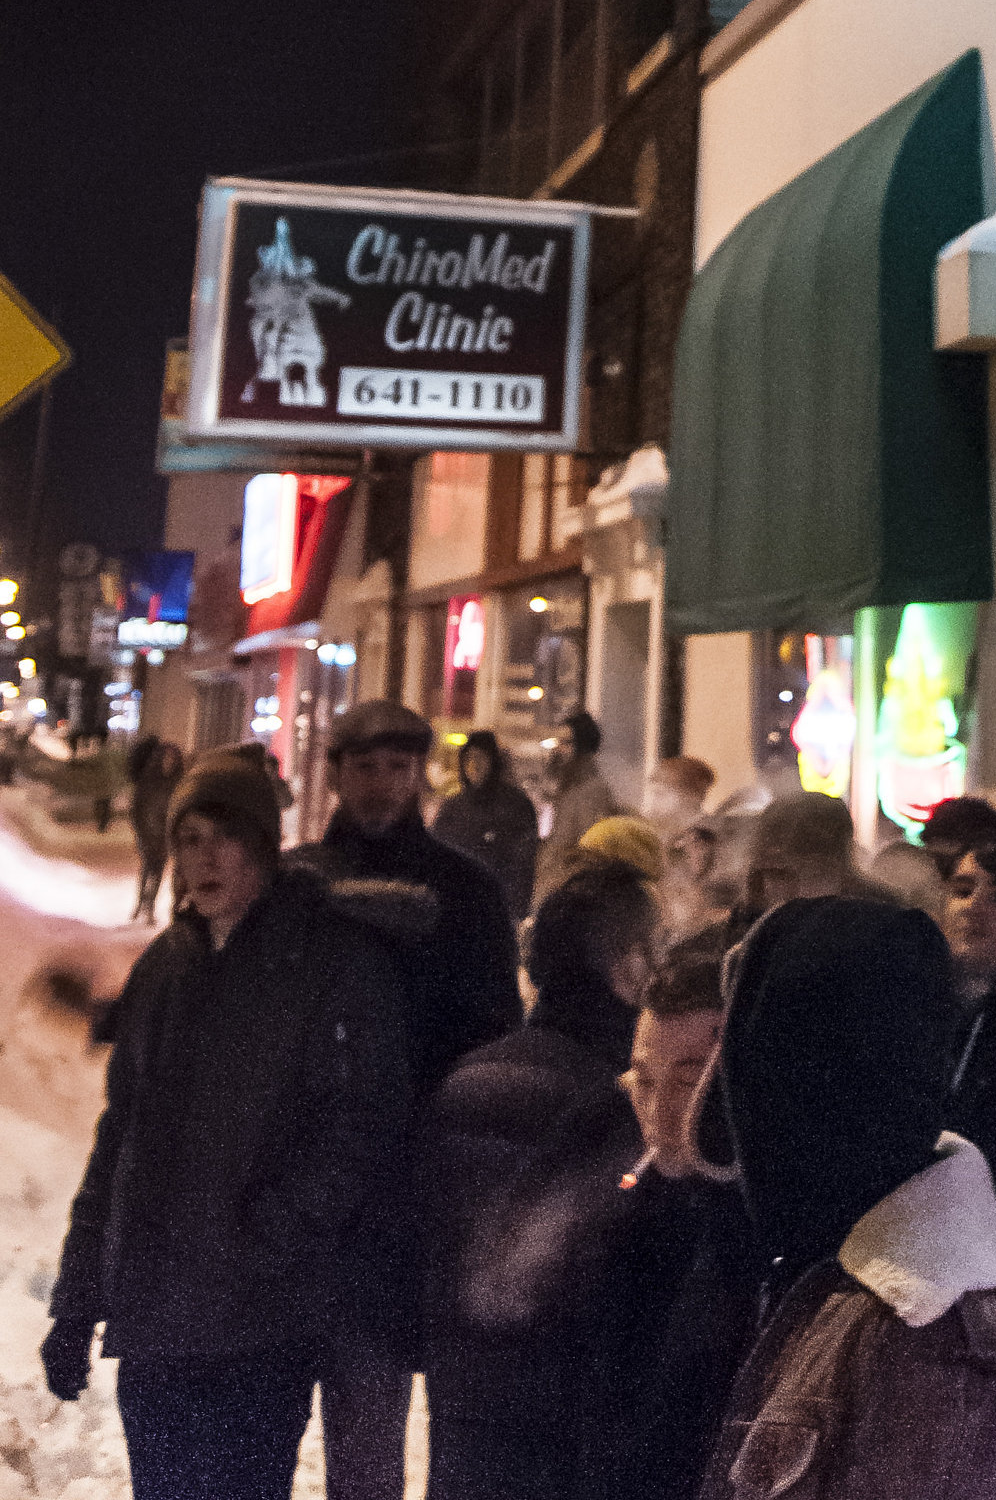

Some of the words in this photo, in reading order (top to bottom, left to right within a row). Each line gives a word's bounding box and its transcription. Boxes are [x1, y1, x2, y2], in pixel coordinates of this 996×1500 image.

[346, 224, 558, 294] ChiroMed
[384, 291, 514, 353] Clinic
[353, 376, 533, 411] 641-1110
